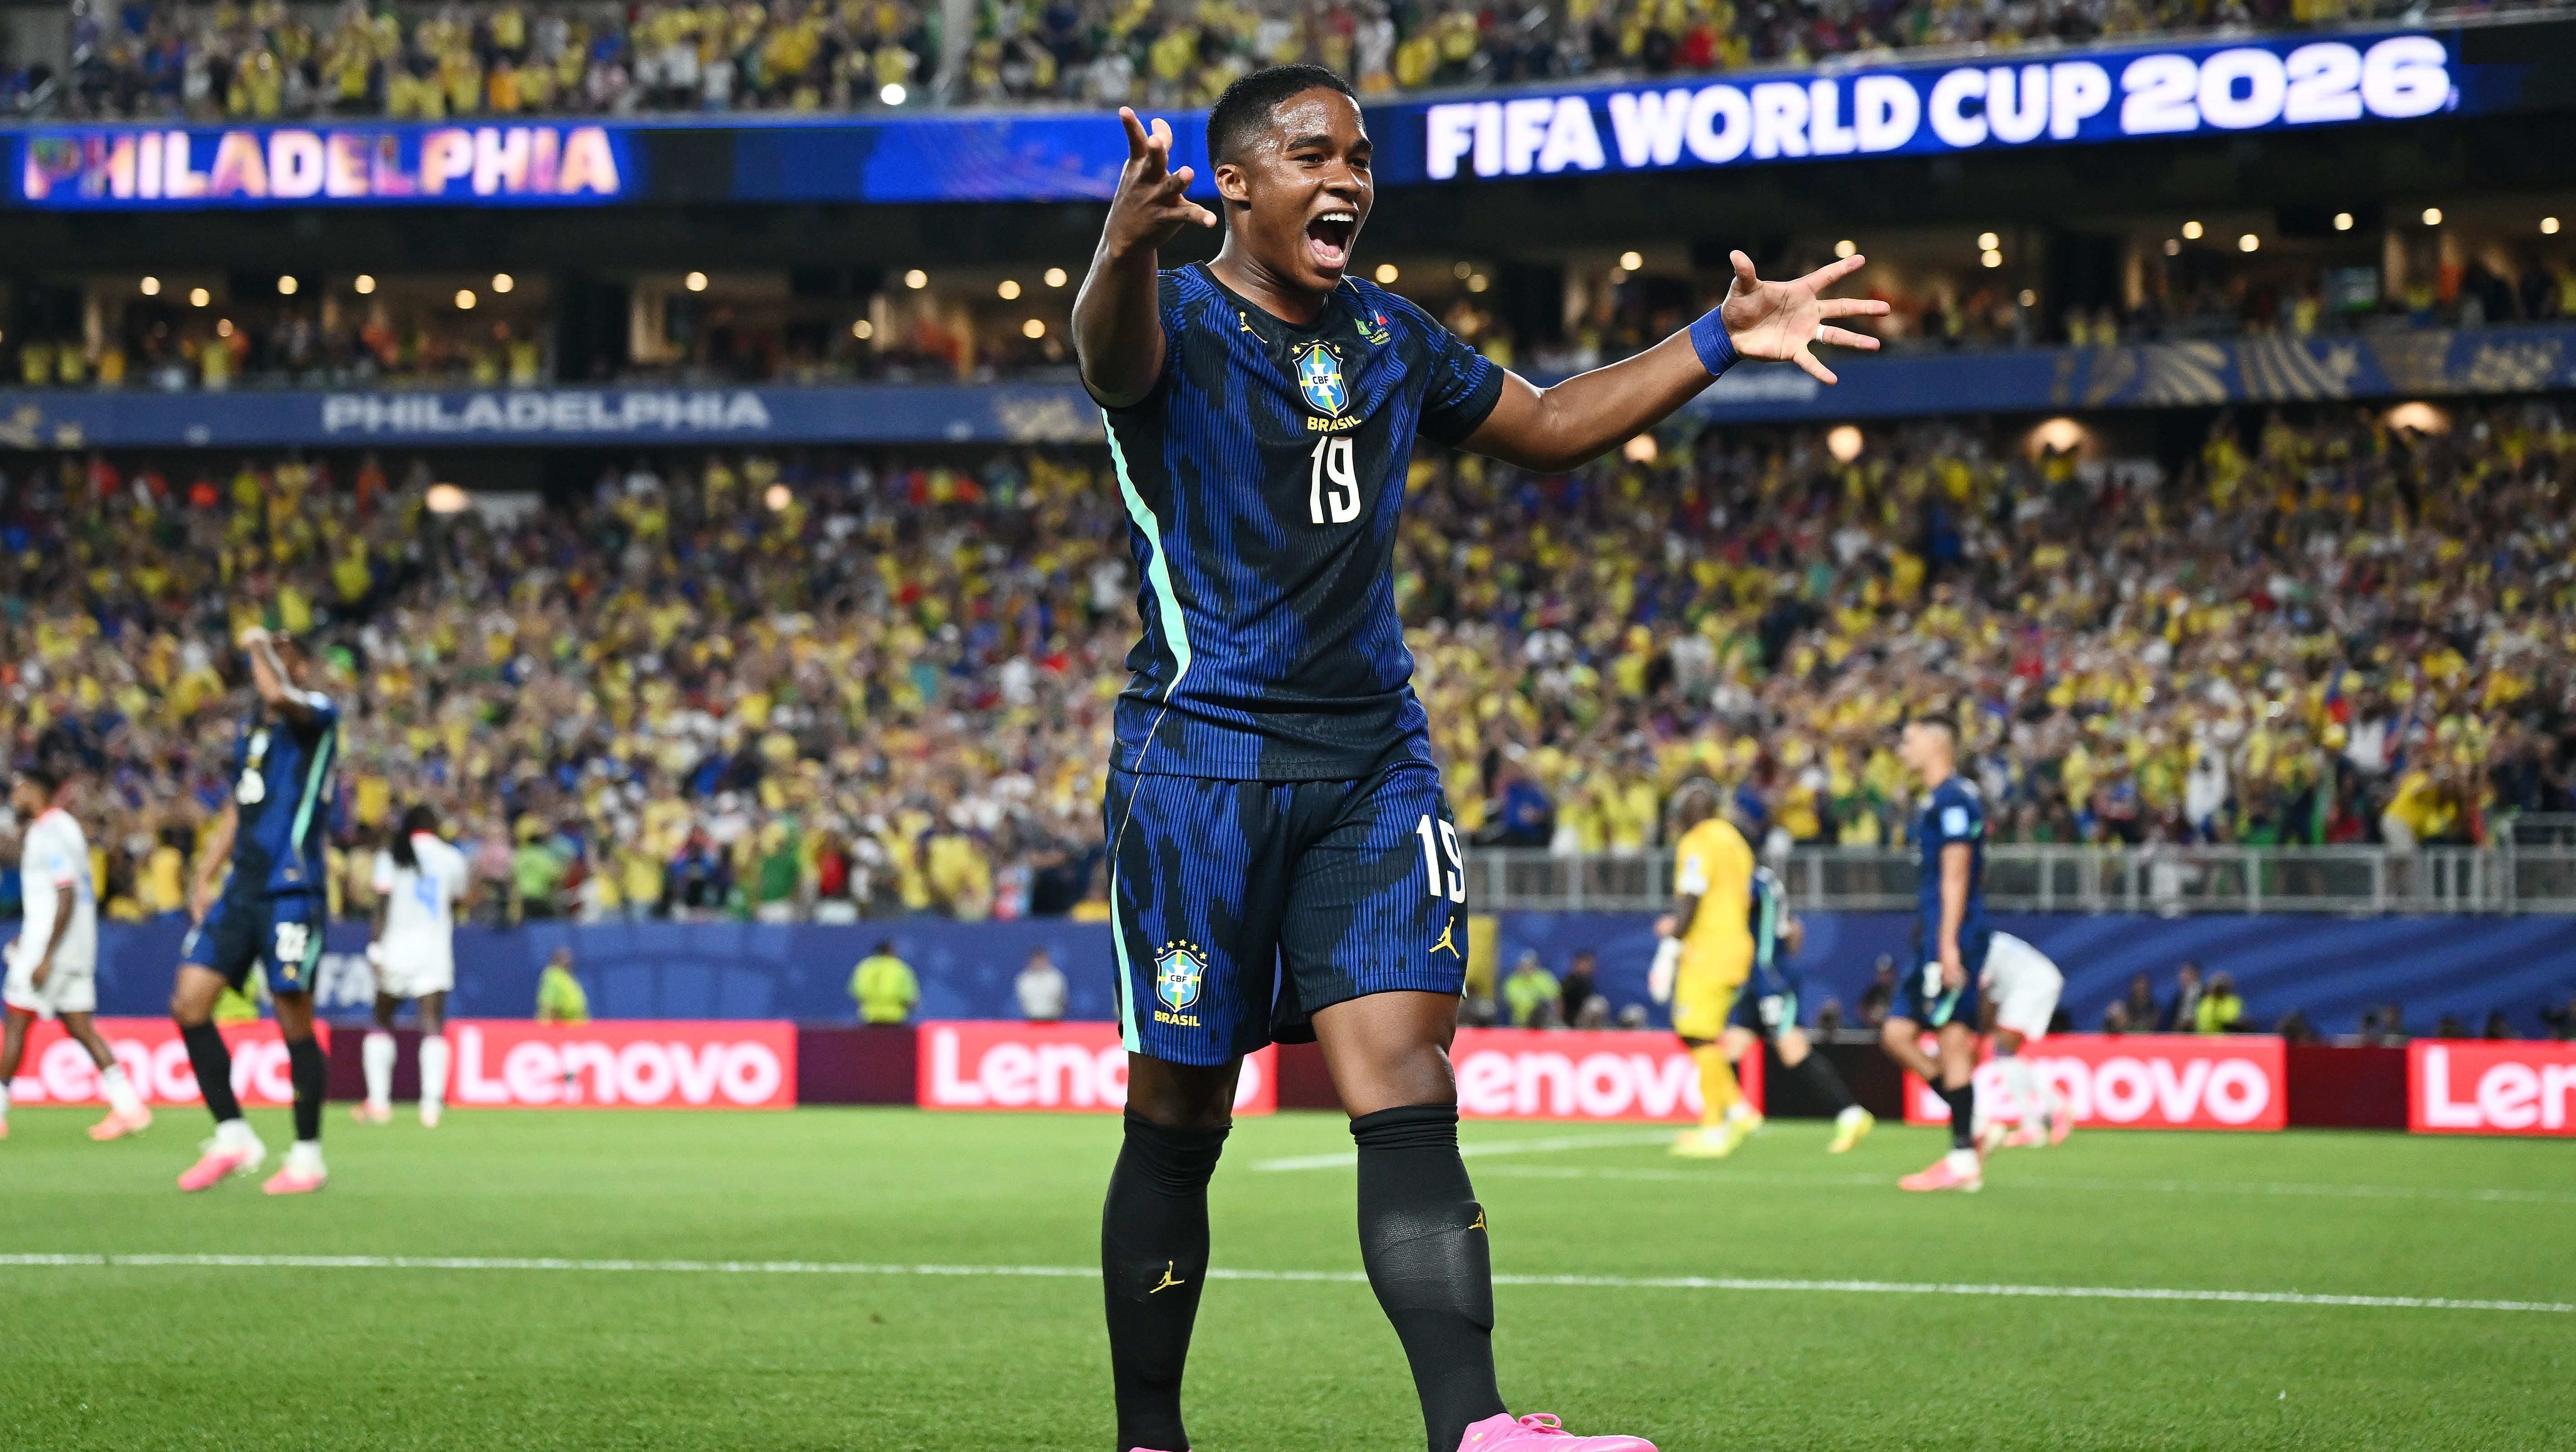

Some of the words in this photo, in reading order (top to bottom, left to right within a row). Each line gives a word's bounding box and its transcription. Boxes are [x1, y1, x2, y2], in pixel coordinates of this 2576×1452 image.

[1427, 96, 1605, 180] FIFA
[1608, 74, 1920, 167] WORLD
[1928, 61, 2111, 147] CUP
[2120, 35, 2451, 135] 2026
[24, 126, 620, 199] PHILADELPHIA
[323, 392, 770, 432] PHILADELPHIA
[1312, 376, 1329, 384] CBF
[1307, 415, 1362, 432] BRASIL
[1310, 436, 1361, 524] 19
[1416, 814, 1465, 904] 19
[1154, 1010, 1201, 1027] BRASIL
[457, 1025, 781, 1105] Lenovo
[931, 1026, 1262, 1107] Leno
[1457, 1050, 1705, 1117] enov
